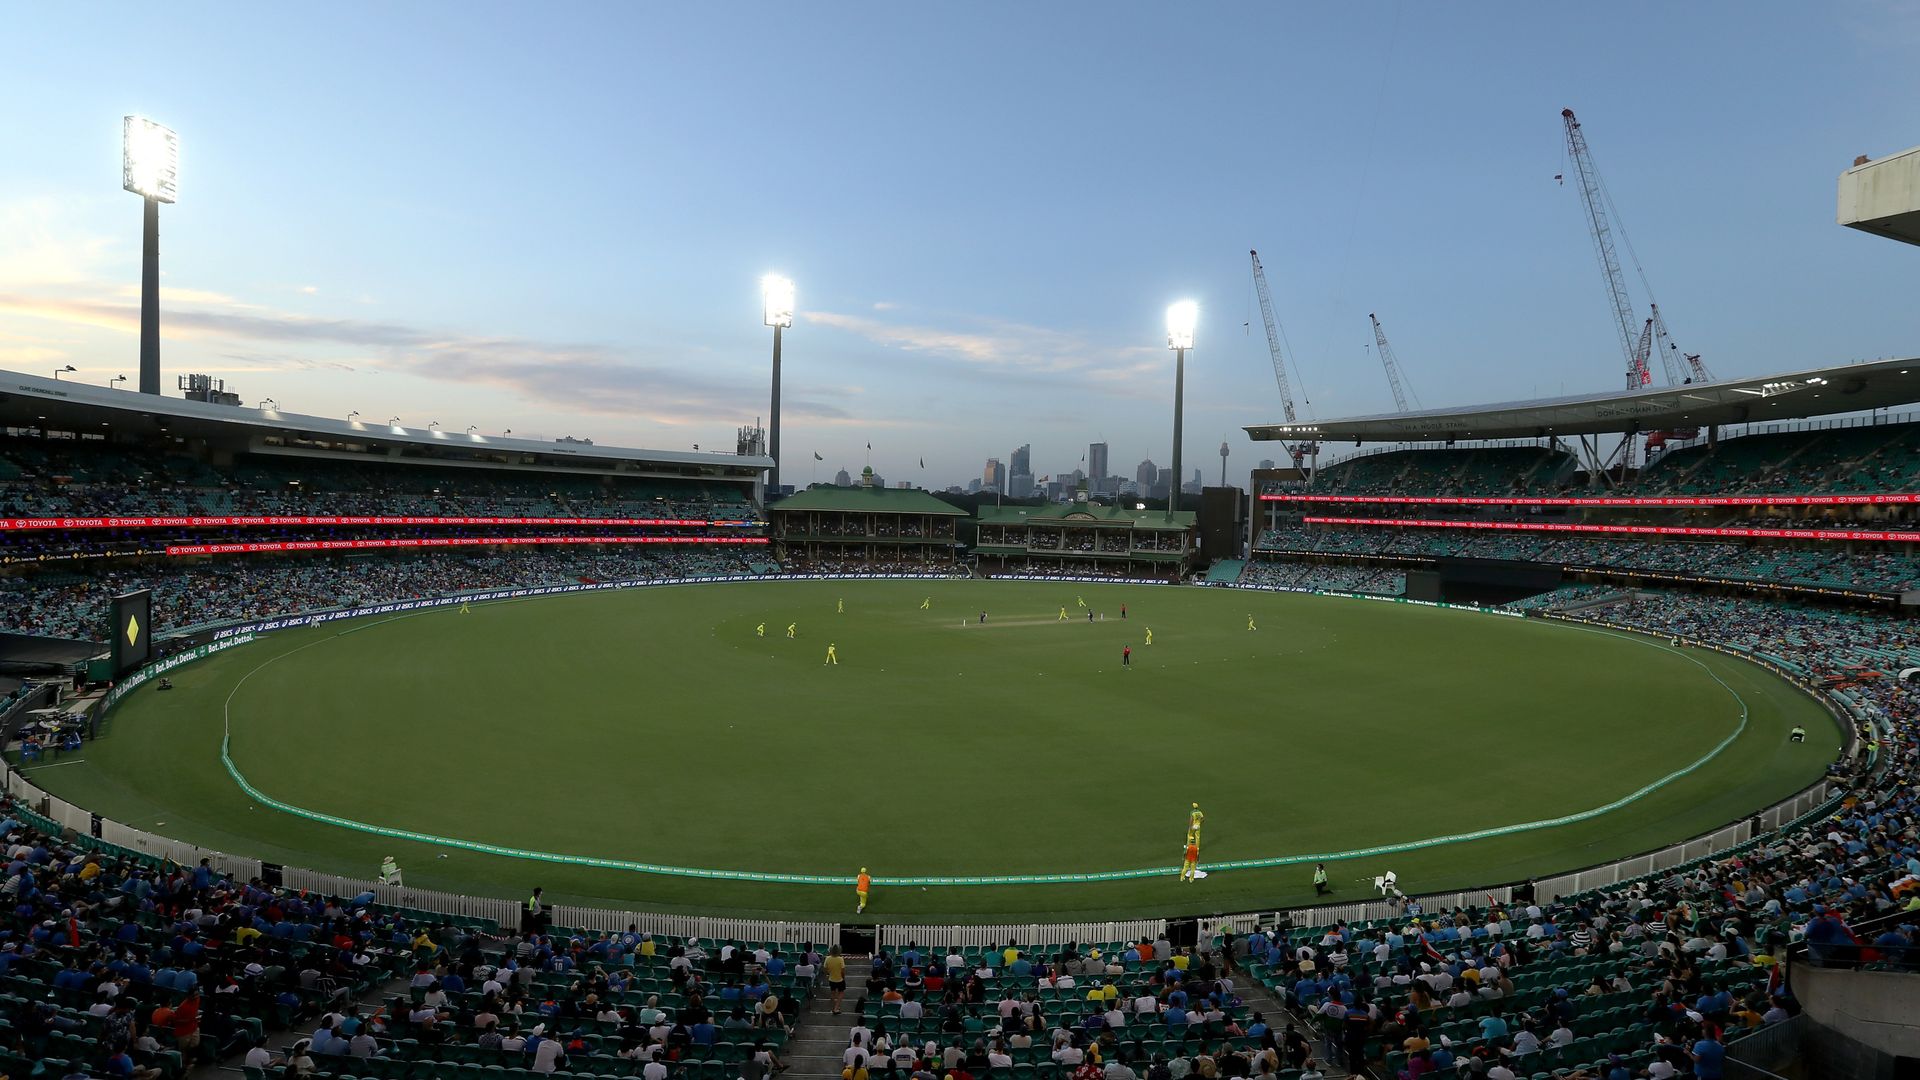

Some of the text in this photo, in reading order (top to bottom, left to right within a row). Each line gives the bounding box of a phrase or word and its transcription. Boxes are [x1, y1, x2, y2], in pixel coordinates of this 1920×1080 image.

[208, 633, 253, 653] Bat. Bowl. Dettol.
[156, 650, 198, 673] Bat. Bowl. Dettol.
[123, 680, 132, 692] Bowl.
[132, 671, 147, 686] Dettol.
[554, 962, 563, 971] 10
